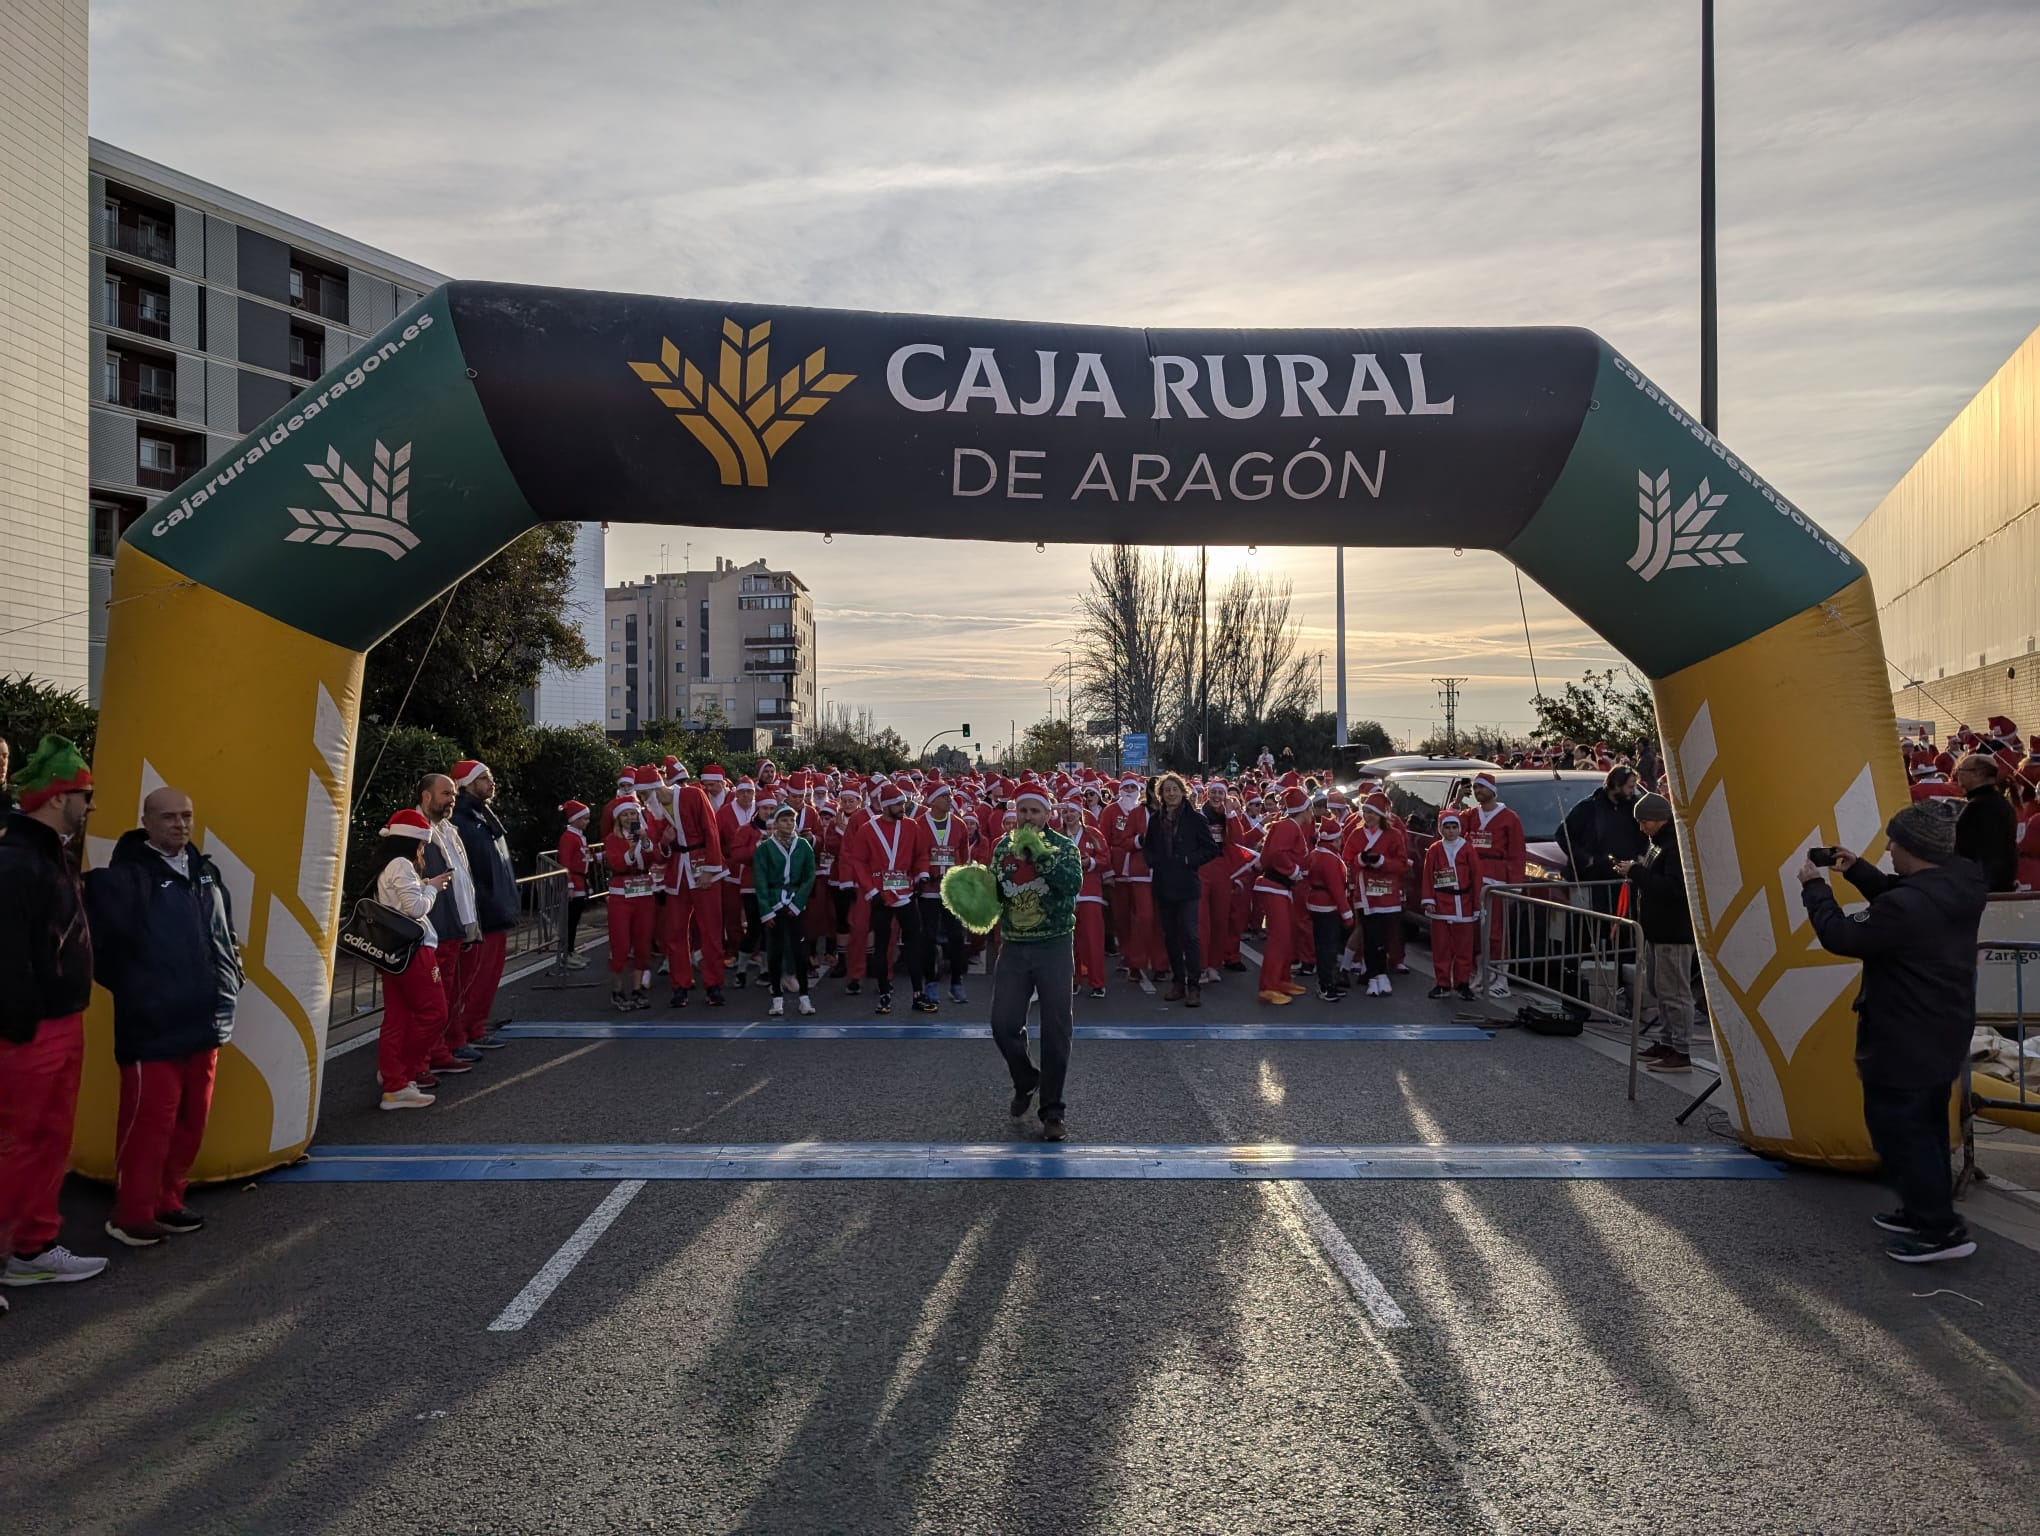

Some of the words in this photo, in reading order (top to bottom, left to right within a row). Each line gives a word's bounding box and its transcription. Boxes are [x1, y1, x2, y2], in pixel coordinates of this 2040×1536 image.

[886, 343, 1127, 419] CAJA
[1150, 352, 1455, 420] RURAL
[151, 312, 435, 538] cajaruraldearagon.es
[951, 447, 1046, 500] DE
[1071, 437, 1387, 502] ARAGÓN
[1613, 356, 1851, 566] cajaruraldearagon.es
[343, 932, 385, 959] adidas
[1985, 950, 2040, 965] Zarago
